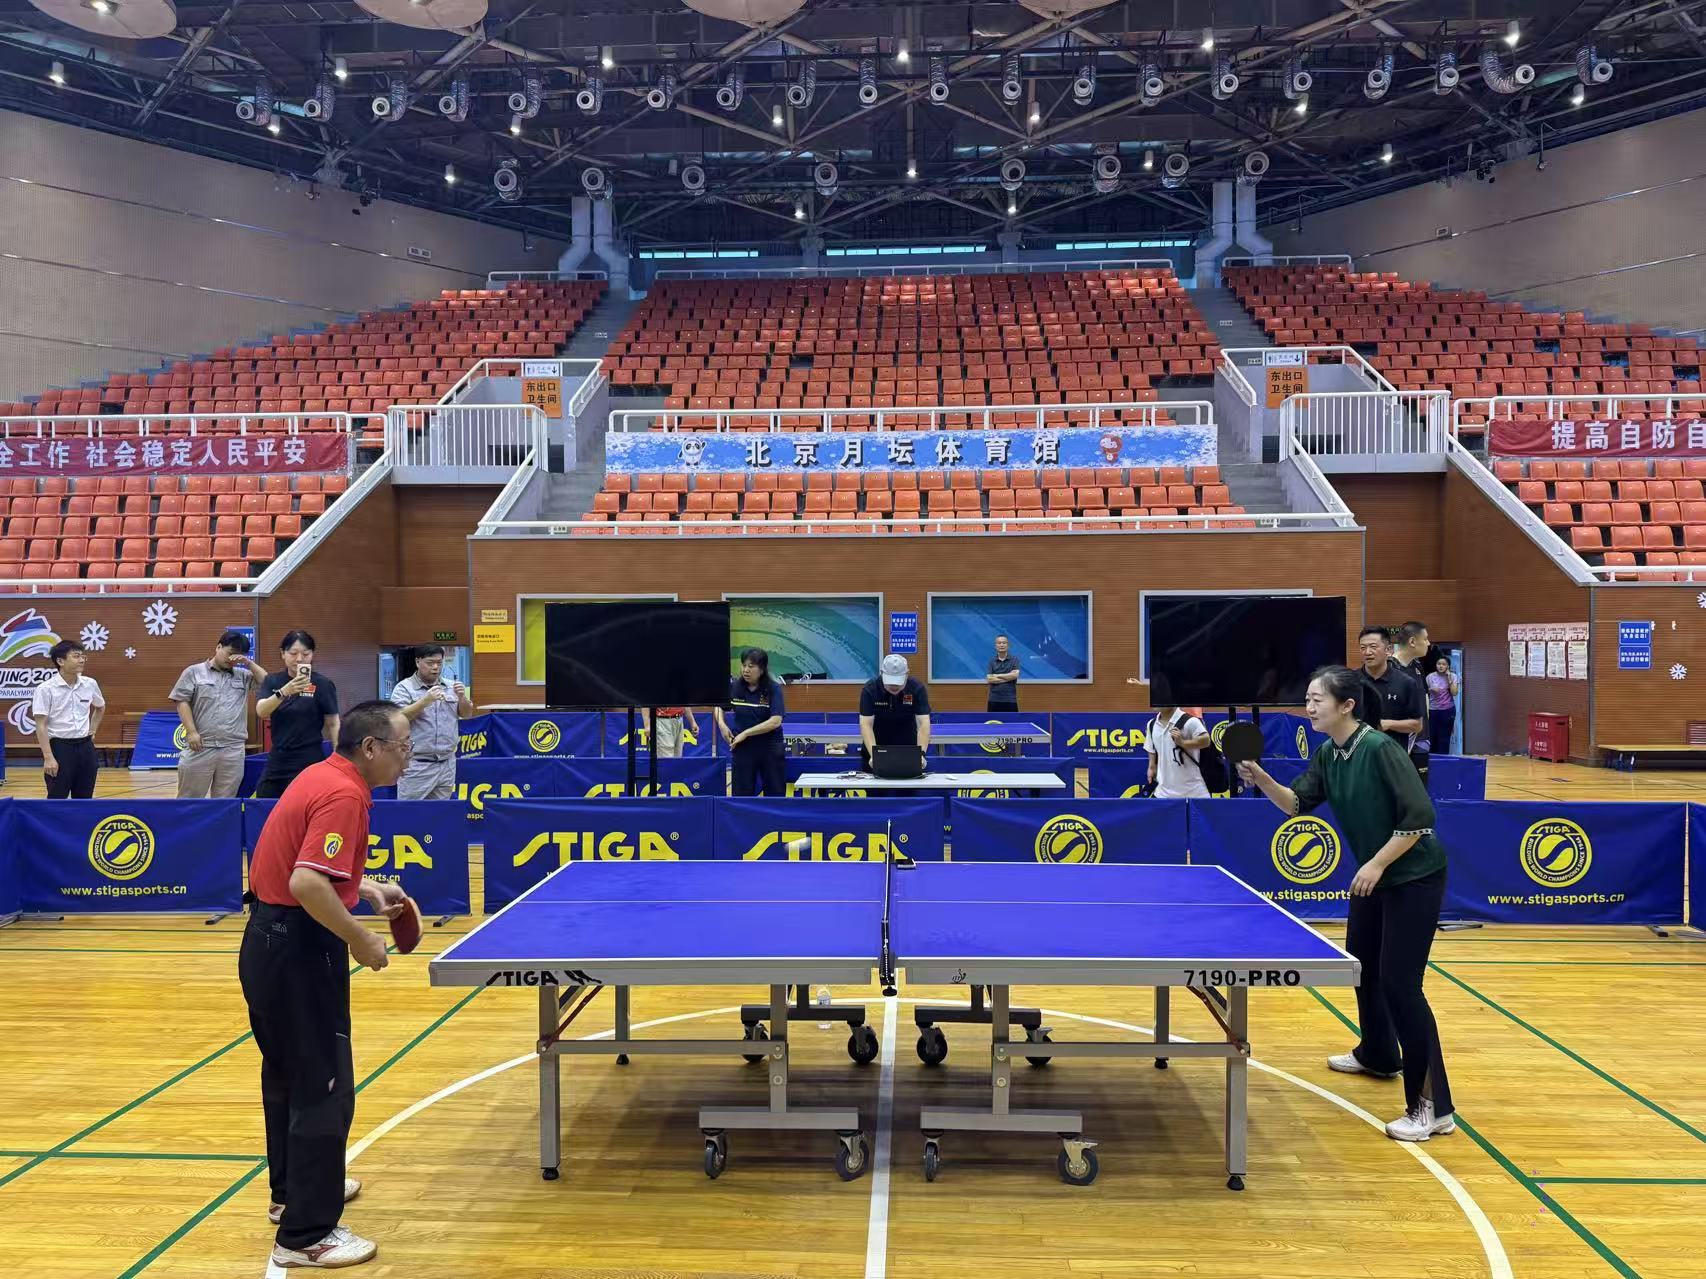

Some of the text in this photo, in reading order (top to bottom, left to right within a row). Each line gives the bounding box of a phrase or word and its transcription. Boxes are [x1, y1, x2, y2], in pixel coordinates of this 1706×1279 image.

[1271, 371, 1302, 381] 东出口
[526, 382, 556, 392] 东出口
[1271, 384, 1303, 394] 卫生间
[527, 394, 557, 404] 卫生间
[744, 436, 1061, 468] 北京月坛体育馆
[0, 671, 29, 684] JING
[105, 821, 138, 830] STIGA
[1051, 822, 1084, 831] STIGA
[1288, 823, 1321, 832] STIGA
[1536, 825, 1571, 834] STIGA
[61, 885, 187, 897] www.stigasports.cn
[1487, 893, 1625, 907] www.stigasports.cn
[486, 970, 559, 986] STIGA
[1183, 969, 1301, 987] 7190-PRO
